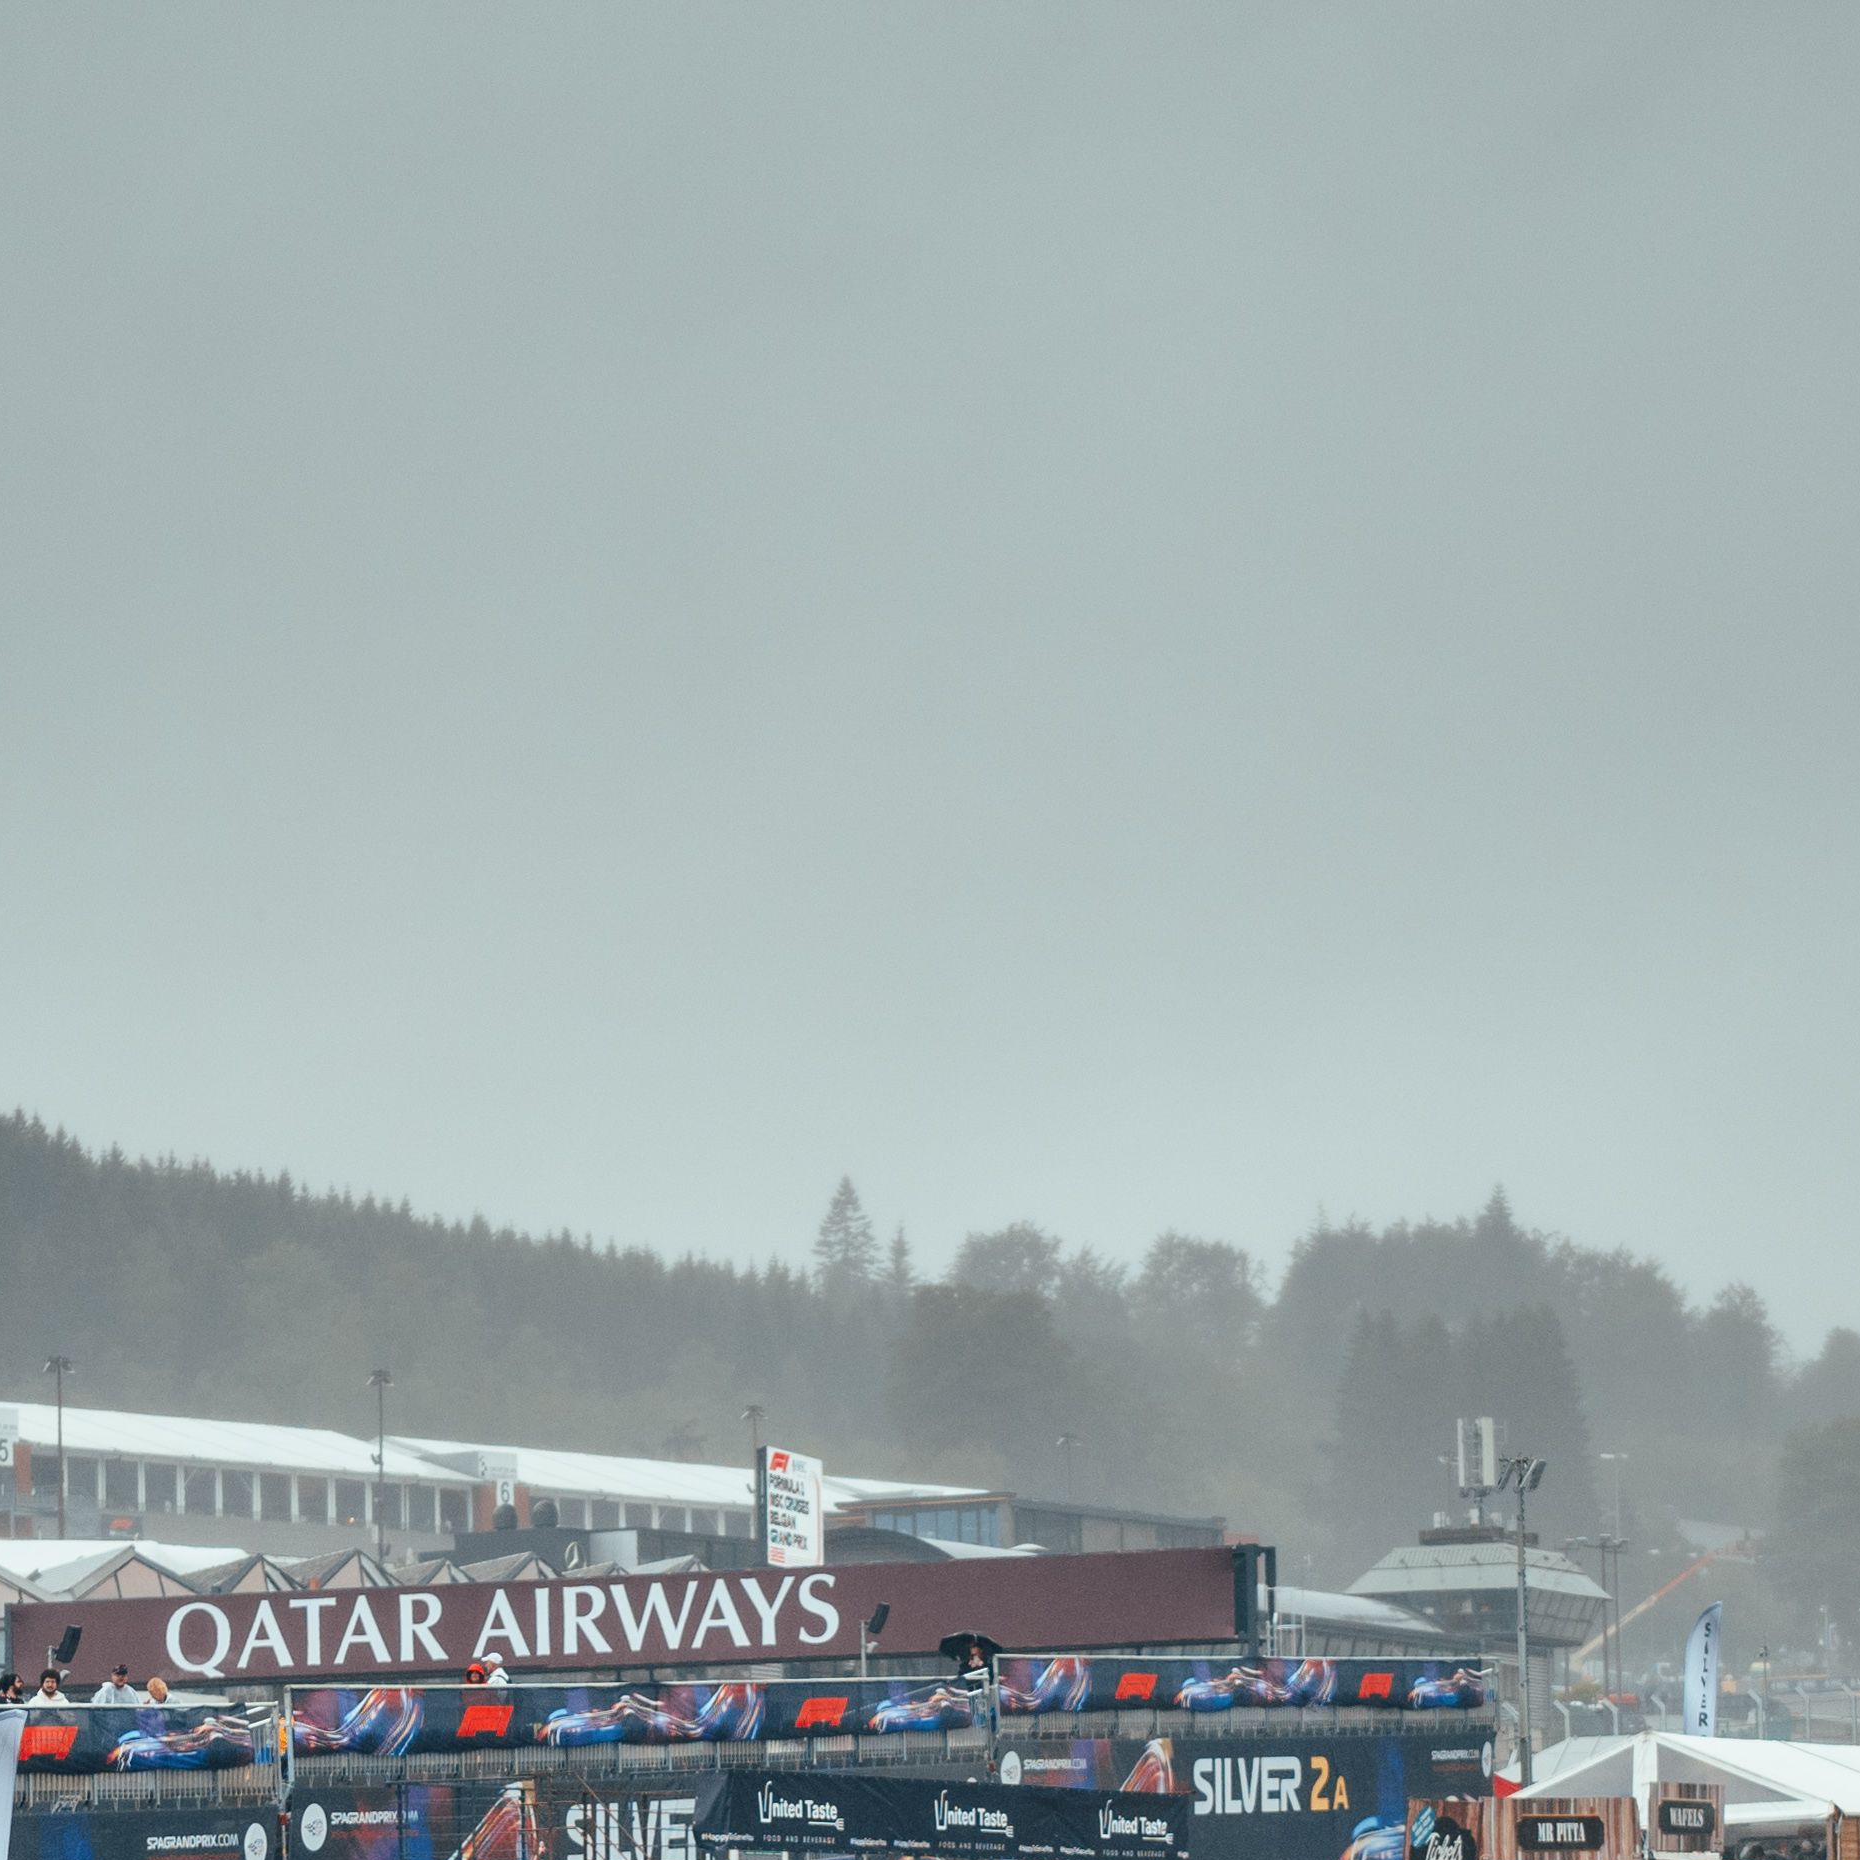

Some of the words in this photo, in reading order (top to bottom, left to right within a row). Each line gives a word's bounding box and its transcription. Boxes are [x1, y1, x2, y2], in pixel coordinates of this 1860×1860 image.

[499, 1482, 510, 1503] 6
[165, 1591, 448, 1676] QATAR
[473, 1571, 840, 1662] AIRWAYS
[1193, 1755, 1302, 1816] SILVER
[804, 1800, 838, 1820] Taste
[977, 1808, 1008, 1827] Taste
[1669, 1807, 1704, 1827] WAFELS
[1138, 1816, 1167, 1835] Taste
[1537, 1822, 1554, 1841] MR
[1556, 1822, 1586, 1842] PITTA
[146, 1833, 239, 1850] SPAGRANDPRIX.COM
[762, 1834, 781, 1842] FOOD
[785, 1835, 799, 1843] AND
[803, 1836, 836, 1844] BEVERAGE
[975, 1843, 1005, 1851] BEVERAGE
